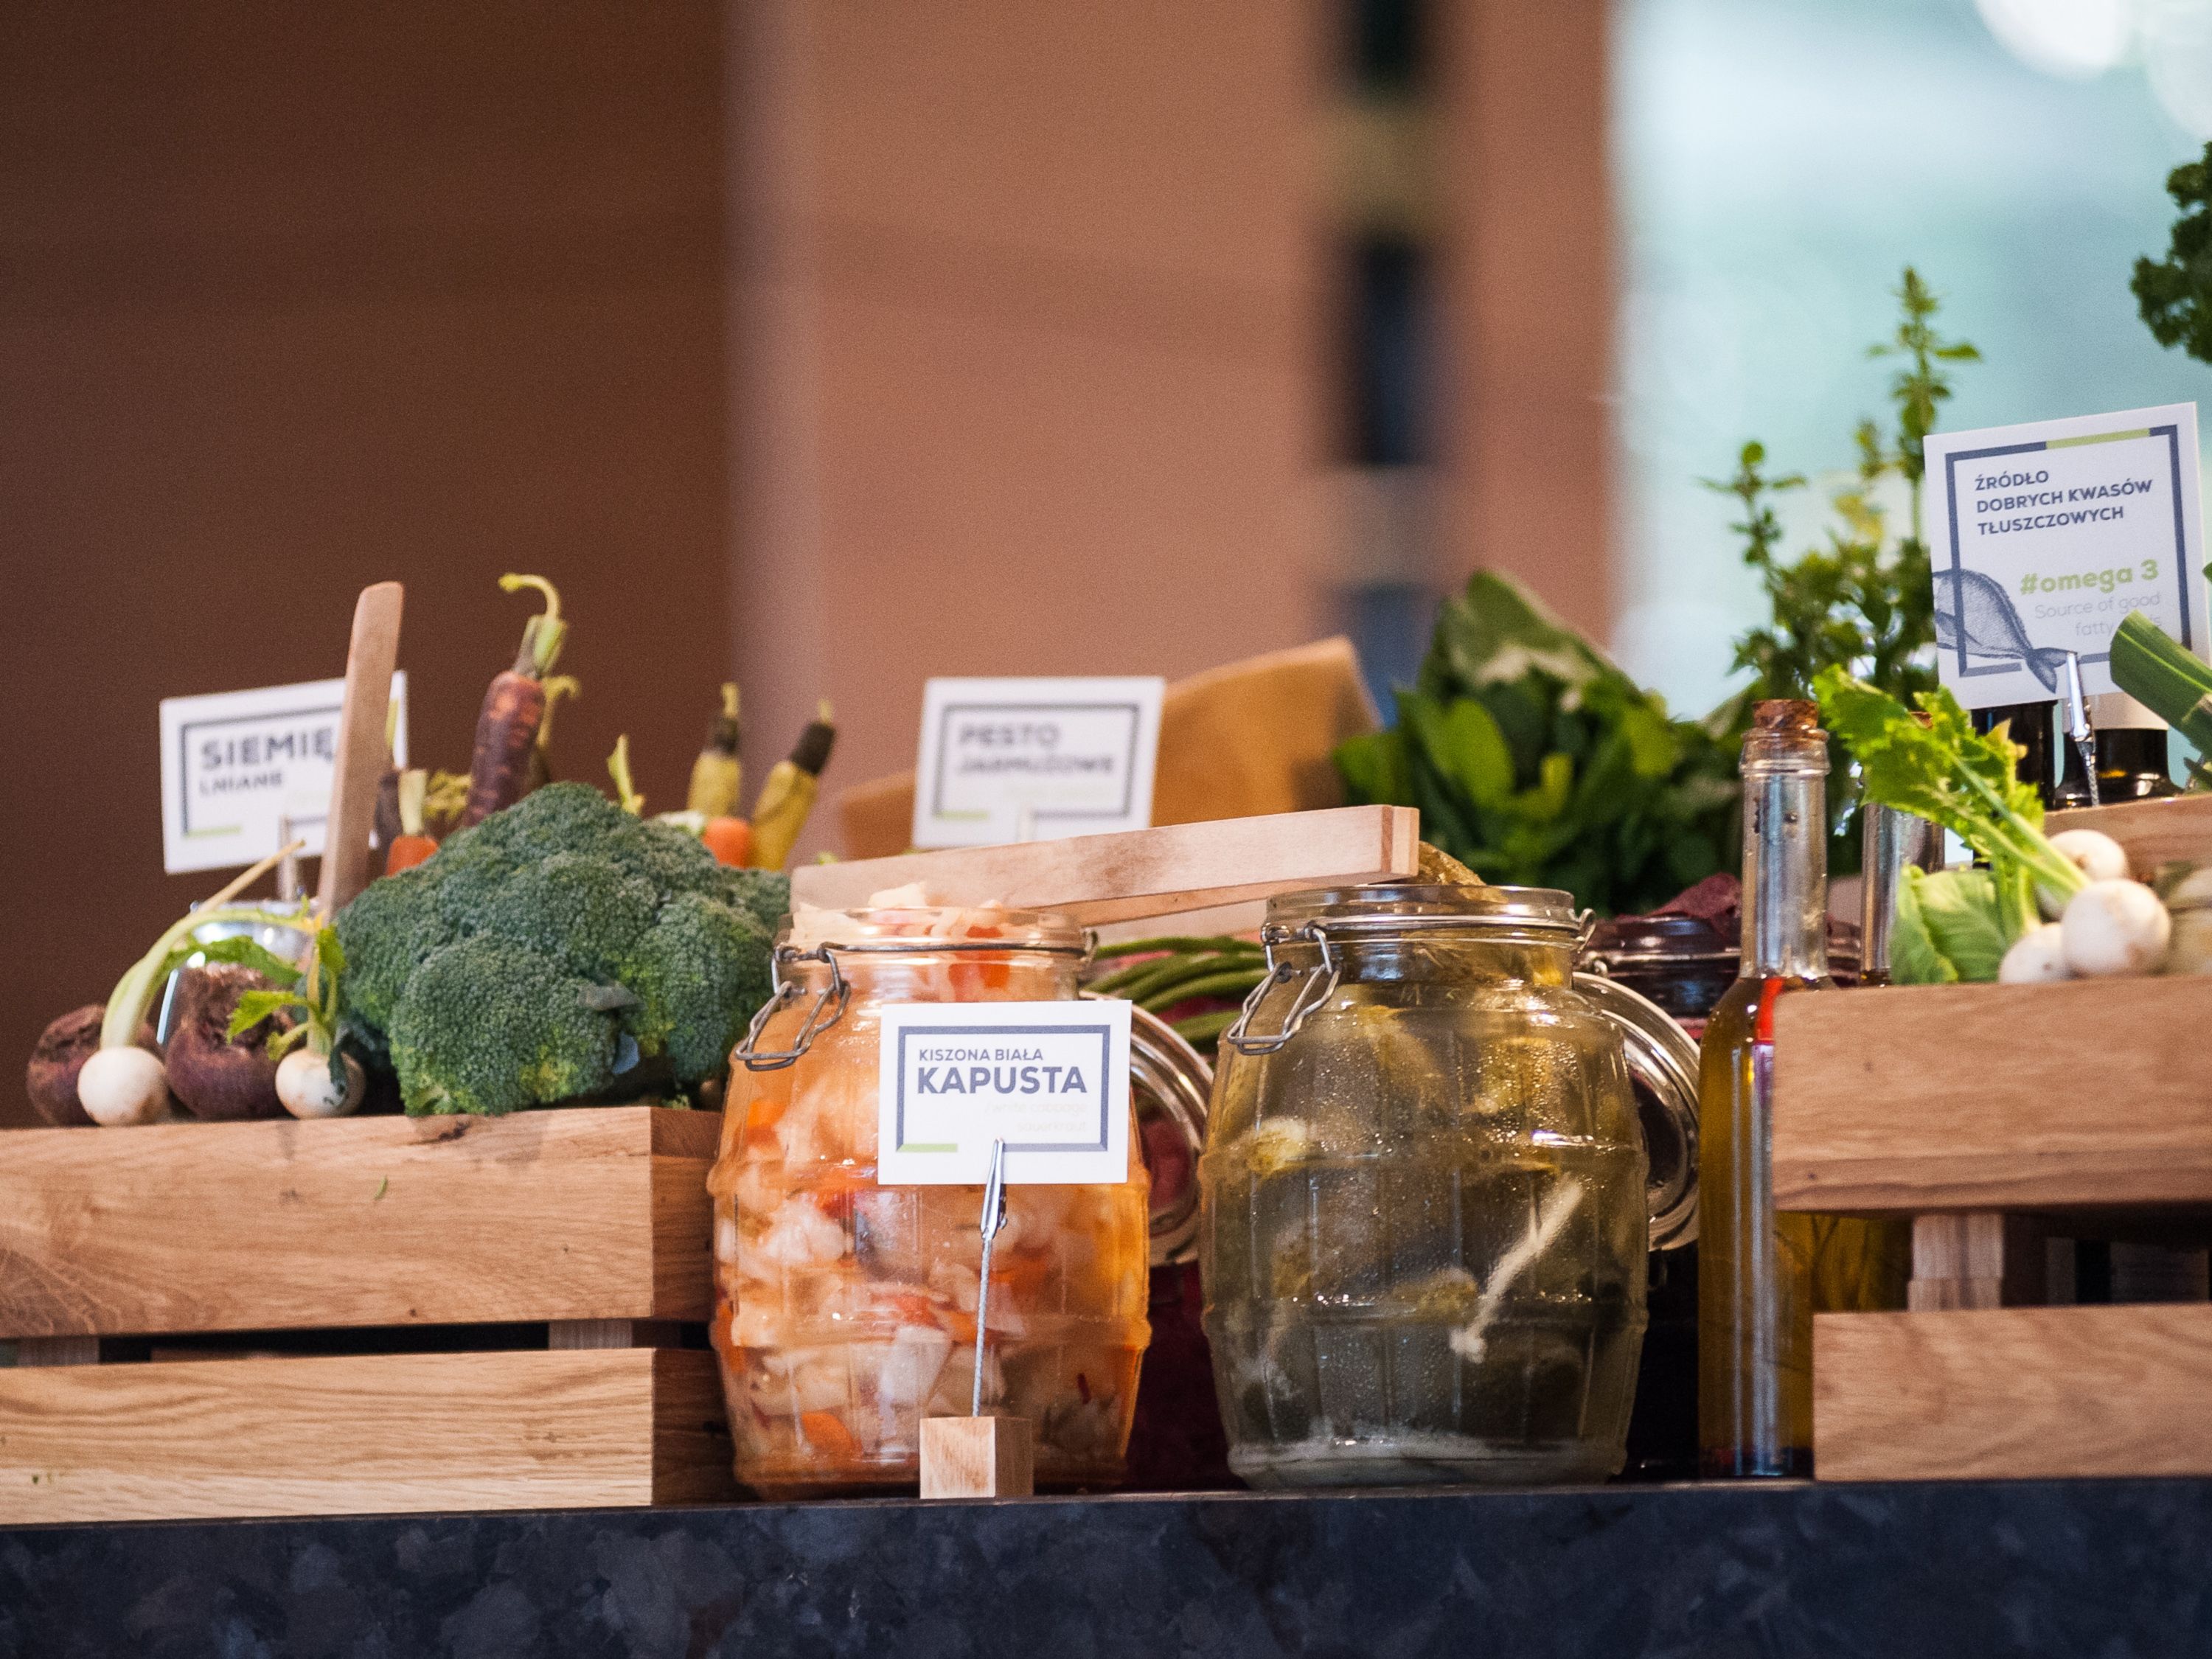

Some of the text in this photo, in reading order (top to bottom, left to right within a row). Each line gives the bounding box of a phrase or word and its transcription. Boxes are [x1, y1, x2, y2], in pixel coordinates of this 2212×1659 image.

[1975, 470, 2049, 491] ŹRÓDŁO
[1977, 479, 2153, 514] DOBRYCH KWASÓW
[1978, 506, 2124, 535] TŁUSZCZOWYCH
[2020, 558, 2160, 595] #omega 3
[2034, 591, 2162, 619] Source of good
[919, 1048, 1044, 1062] KISZONA BIAŁA
[917, 1065, 1088, 1095] KAPUSTA
